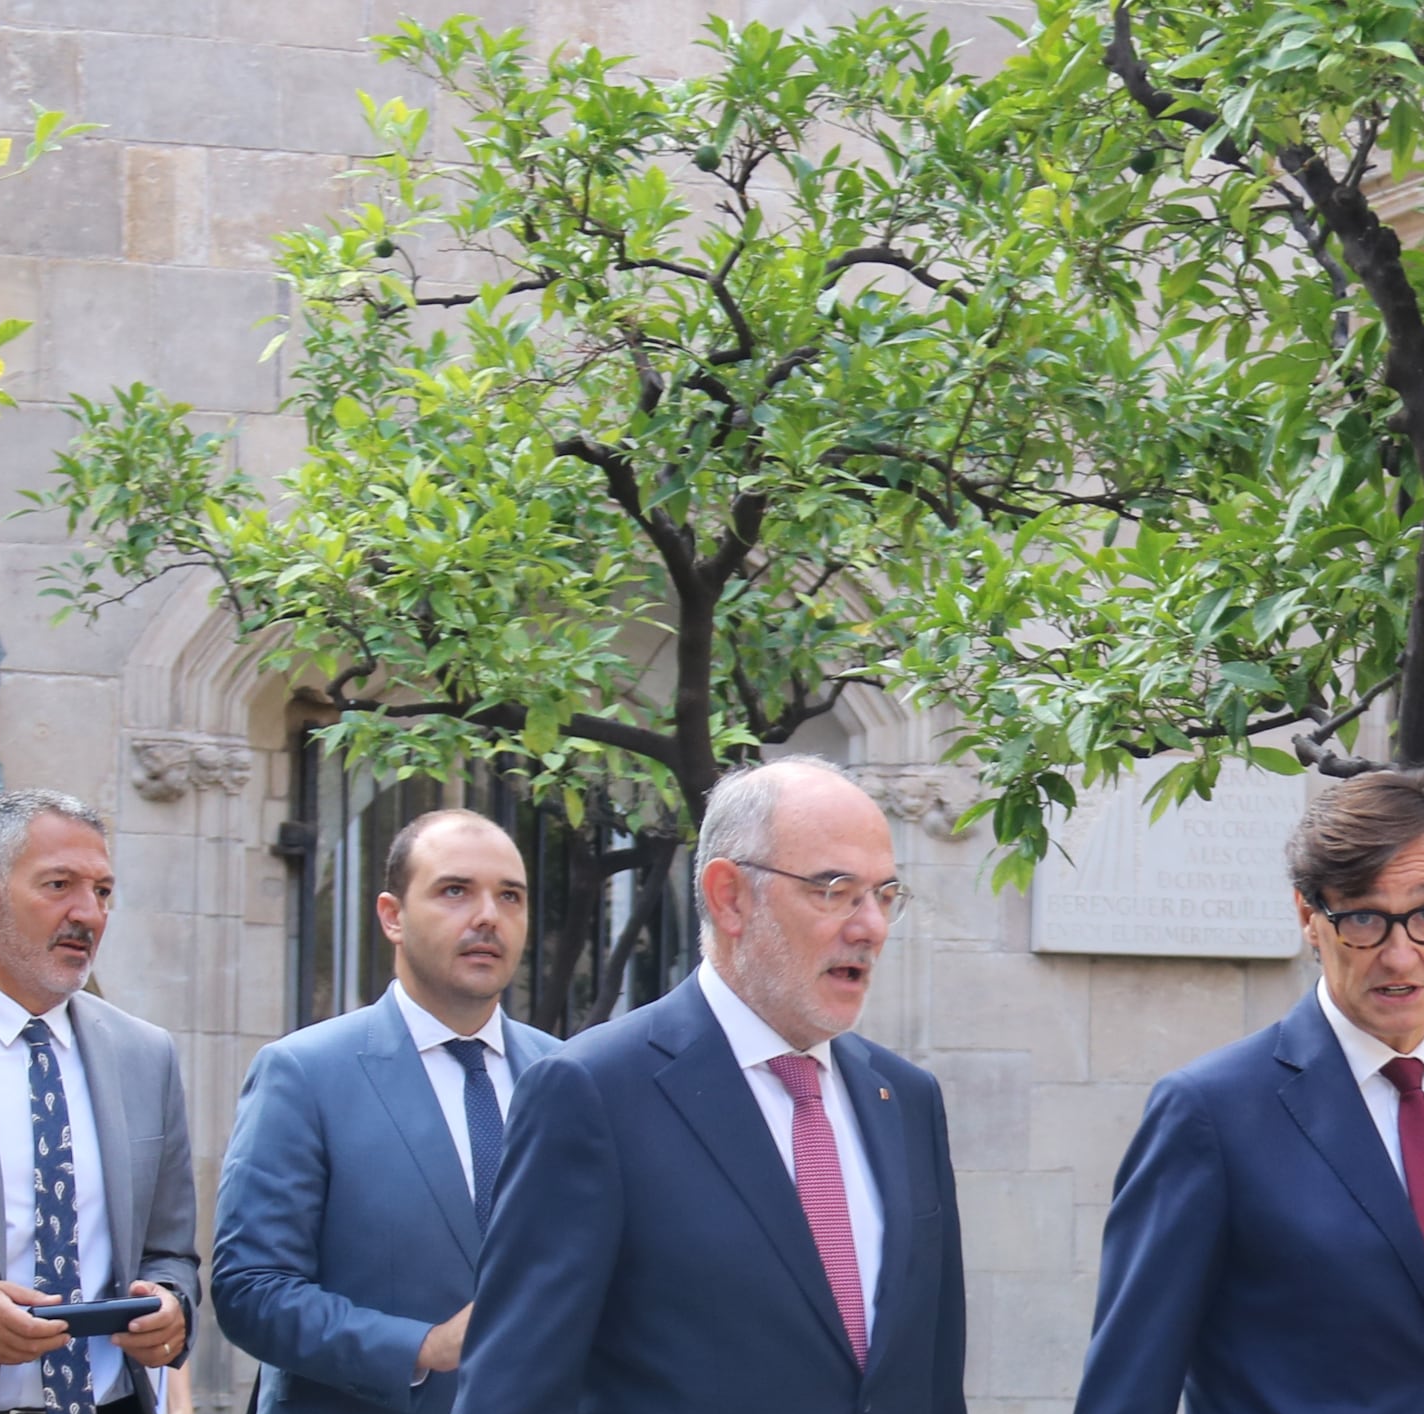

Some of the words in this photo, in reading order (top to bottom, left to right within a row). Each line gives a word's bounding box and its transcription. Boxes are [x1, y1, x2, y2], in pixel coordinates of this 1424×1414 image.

[1235, 847, 1285, 865] COR
[1047, 894, 1175, 918] BERENGUER
[1203, 927, 1296, 946] PRESIDENT
